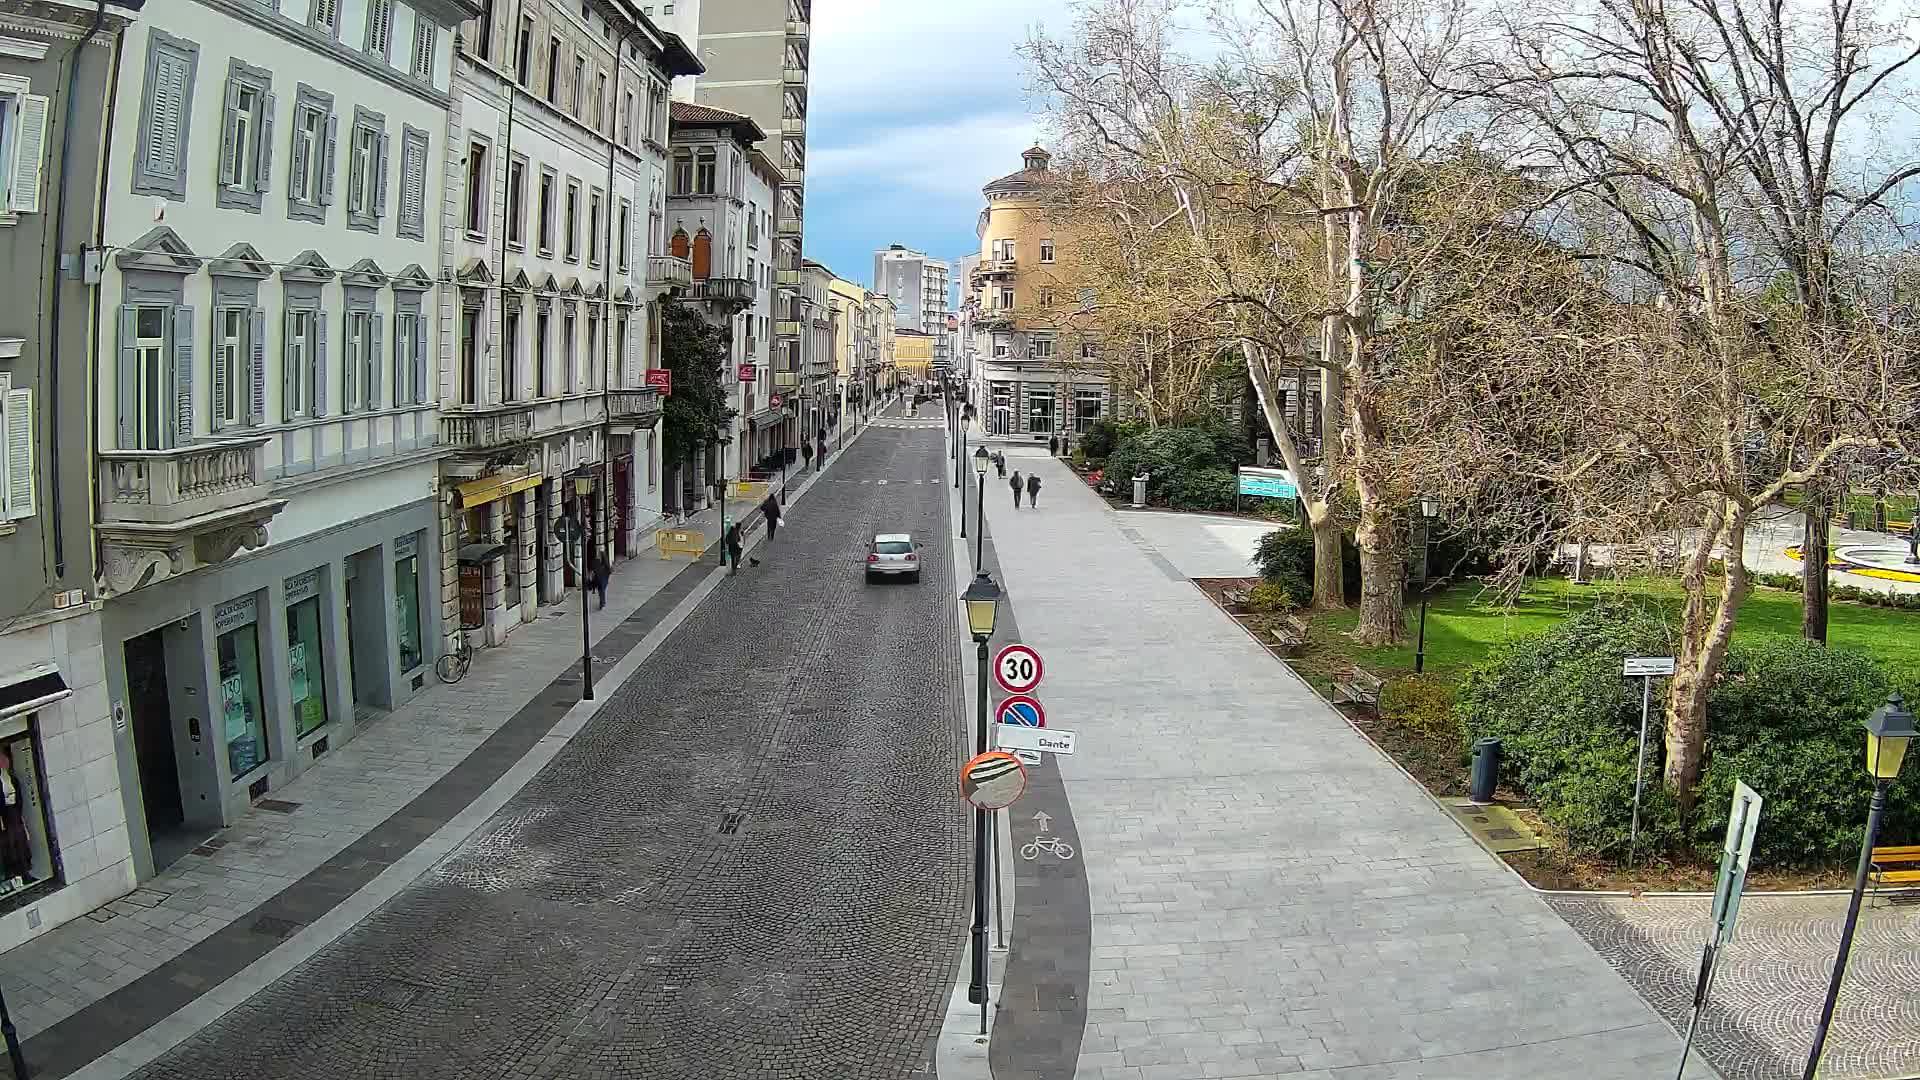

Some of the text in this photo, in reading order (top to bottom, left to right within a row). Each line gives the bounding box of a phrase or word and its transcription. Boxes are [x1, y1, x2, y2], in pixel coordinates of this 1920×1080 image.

[1006, 658, 1033, 680] 30
[224, 678, 241, 701] 130
[1039, 738, 1070, 749] Dante
